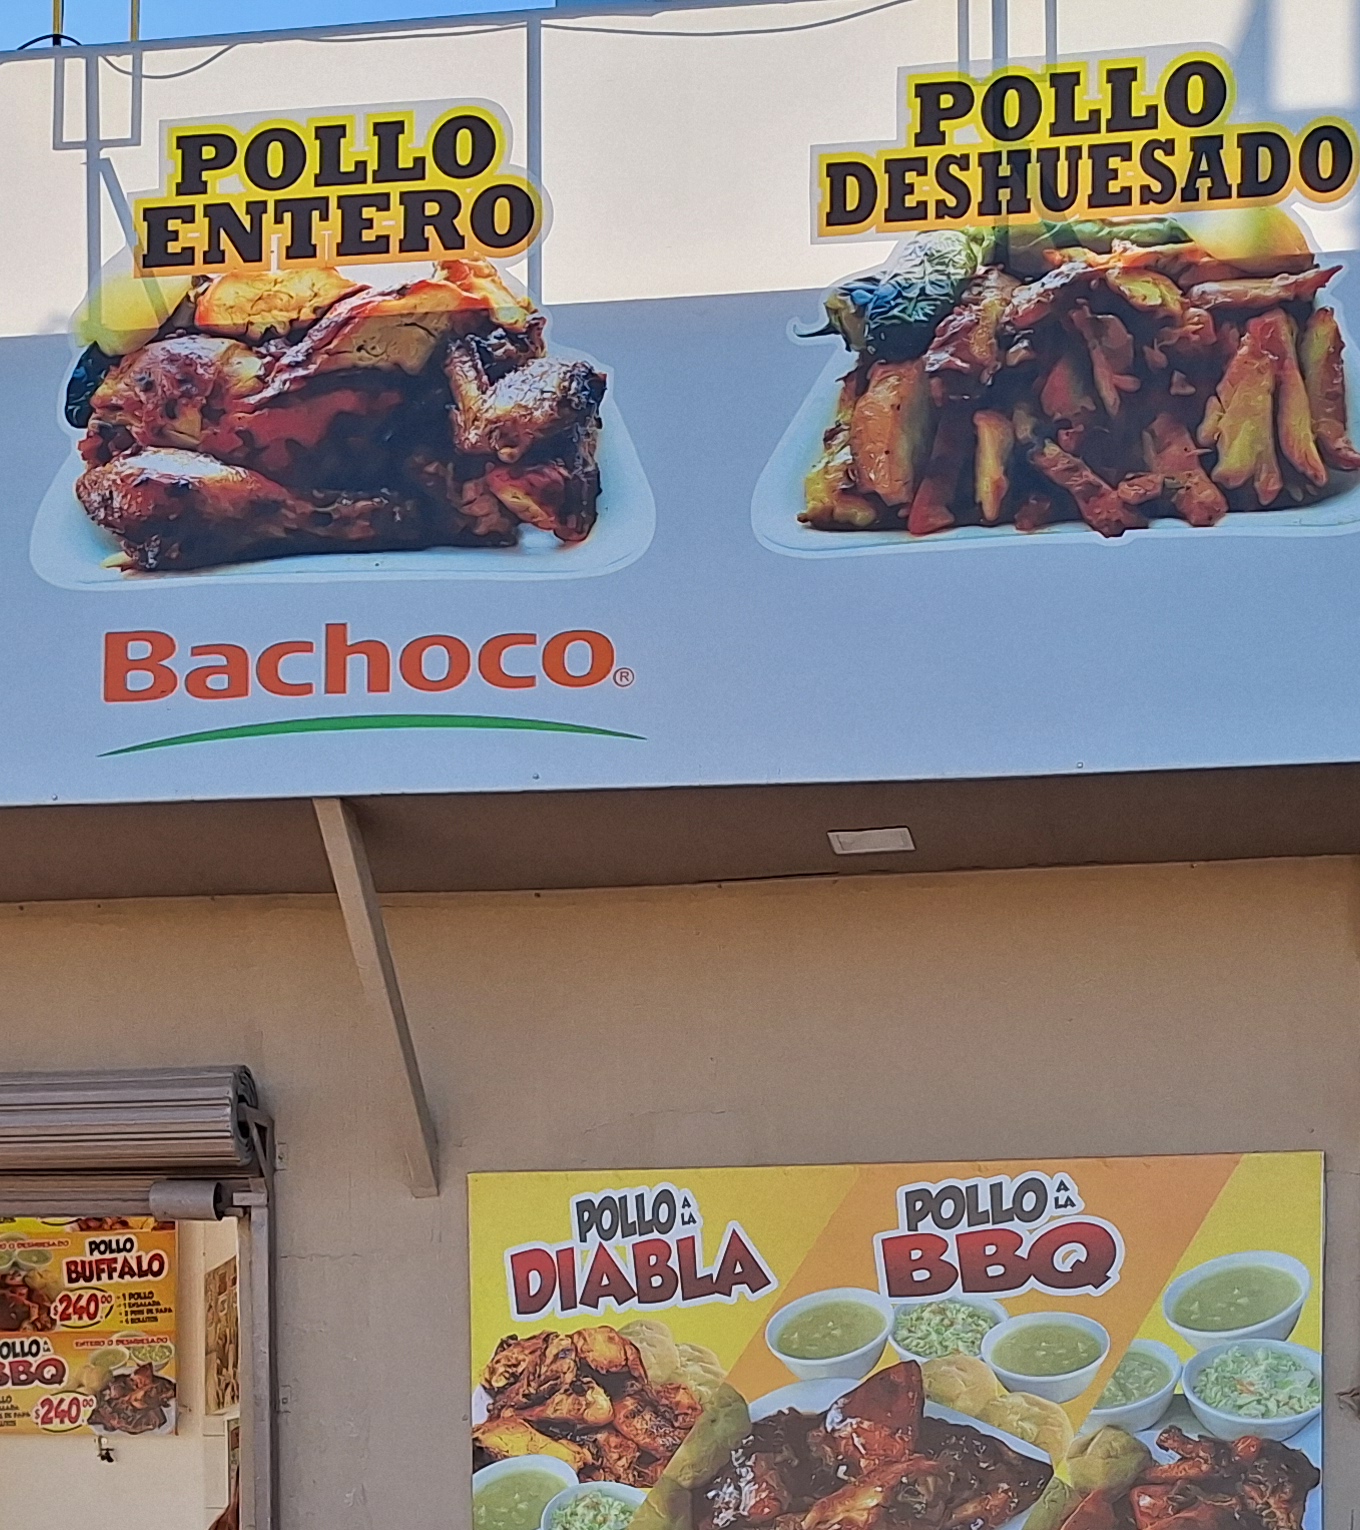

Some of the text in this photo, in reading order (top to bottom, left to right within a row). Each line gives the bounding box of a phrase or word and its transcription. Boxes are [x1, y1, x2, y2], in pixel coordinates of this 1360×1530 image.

[914, 60, 1227, 147] POLLO
[176, 113, 497, 196] POLLO
[825, 125, 1354, 227] DESHUESADO
[142, 184, 536, 269] ENTERO
[576, 1189, 697, 1243] POLLO A LA
[905, 1177, 1076, 1231] POLLO A LA
[66, 1253, 165, 1284] BUFFALO
[88, 1237, 135, 1256] POLLO
[510, 1228, 771, 1315] DIABLA
[882, 1222, 1116, 1298] BBQ
[128, 1291, 154, 1301] POLLO
